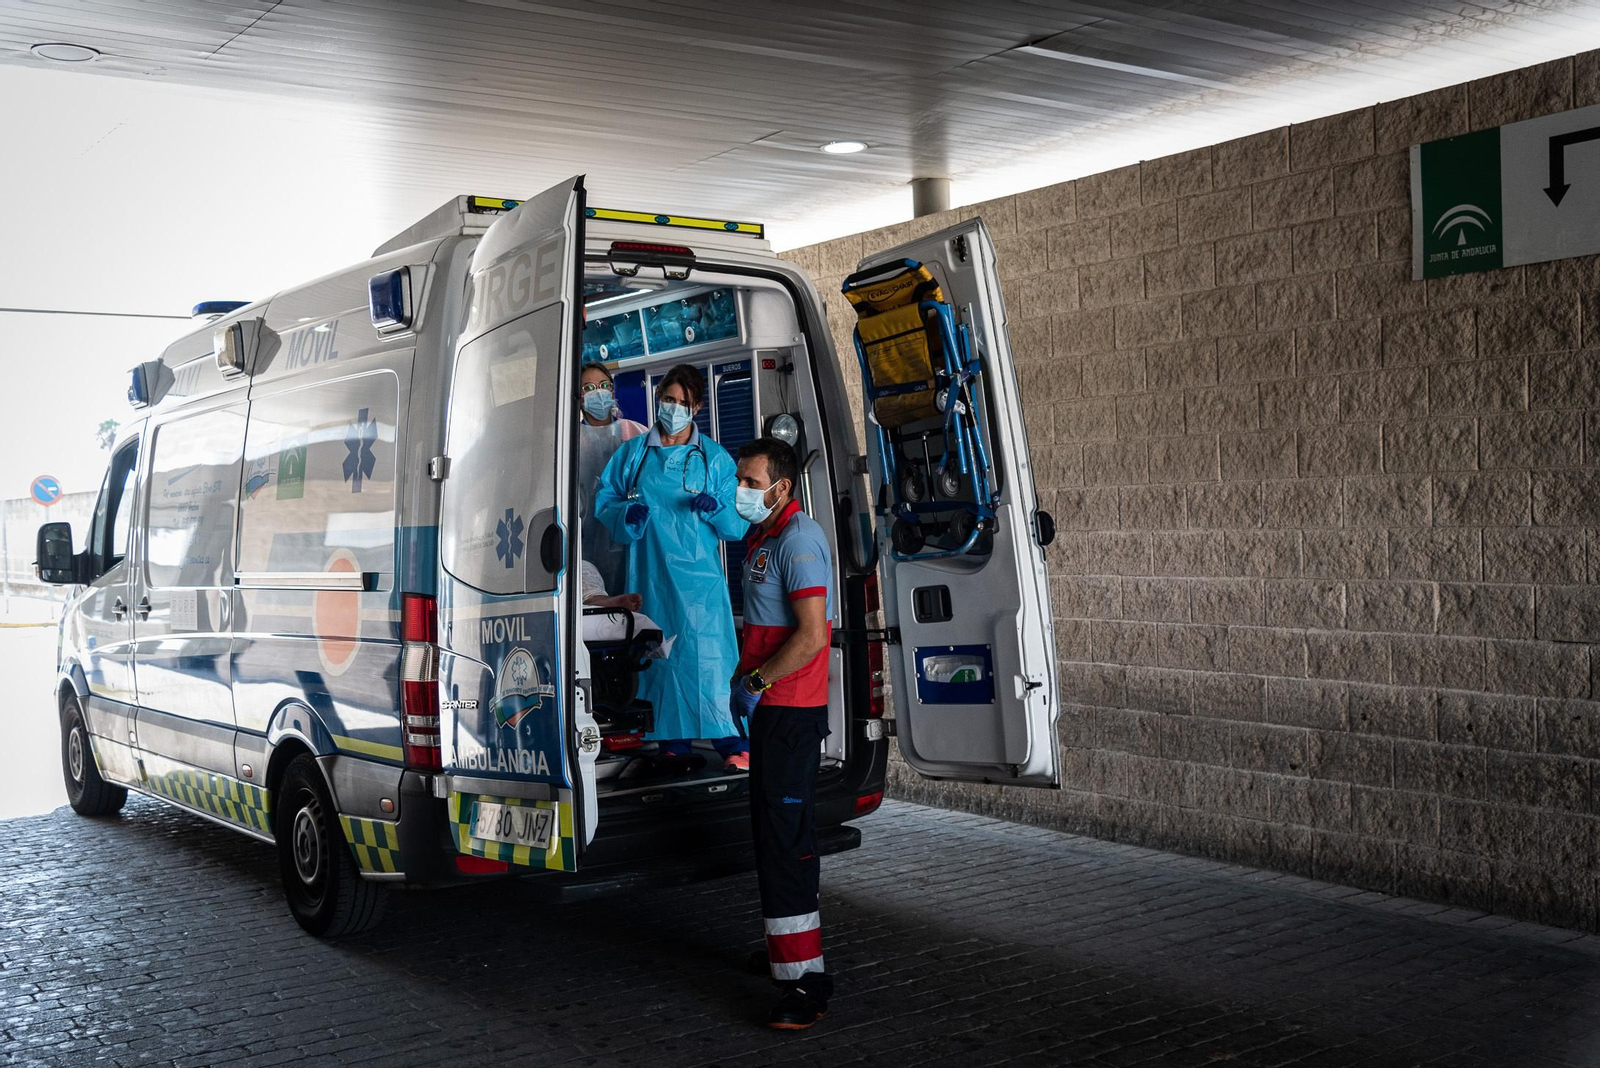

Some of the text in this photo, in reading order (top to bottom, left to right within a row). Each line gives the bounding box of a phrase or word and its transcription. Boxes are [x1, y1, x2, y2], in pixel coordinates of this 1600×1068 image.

[1429, 253, 1449, 263] JUNTA
[1451, 250, 1460, 259] DE
[468, 239, 558, 332] URGE
[285, 319, 340, 370] MOVIL
[481, 617, 532, 644] MOVIL
[450, 745, 550, 776] AMBULANCIA
[517, 812, 549, 843] JNZ
